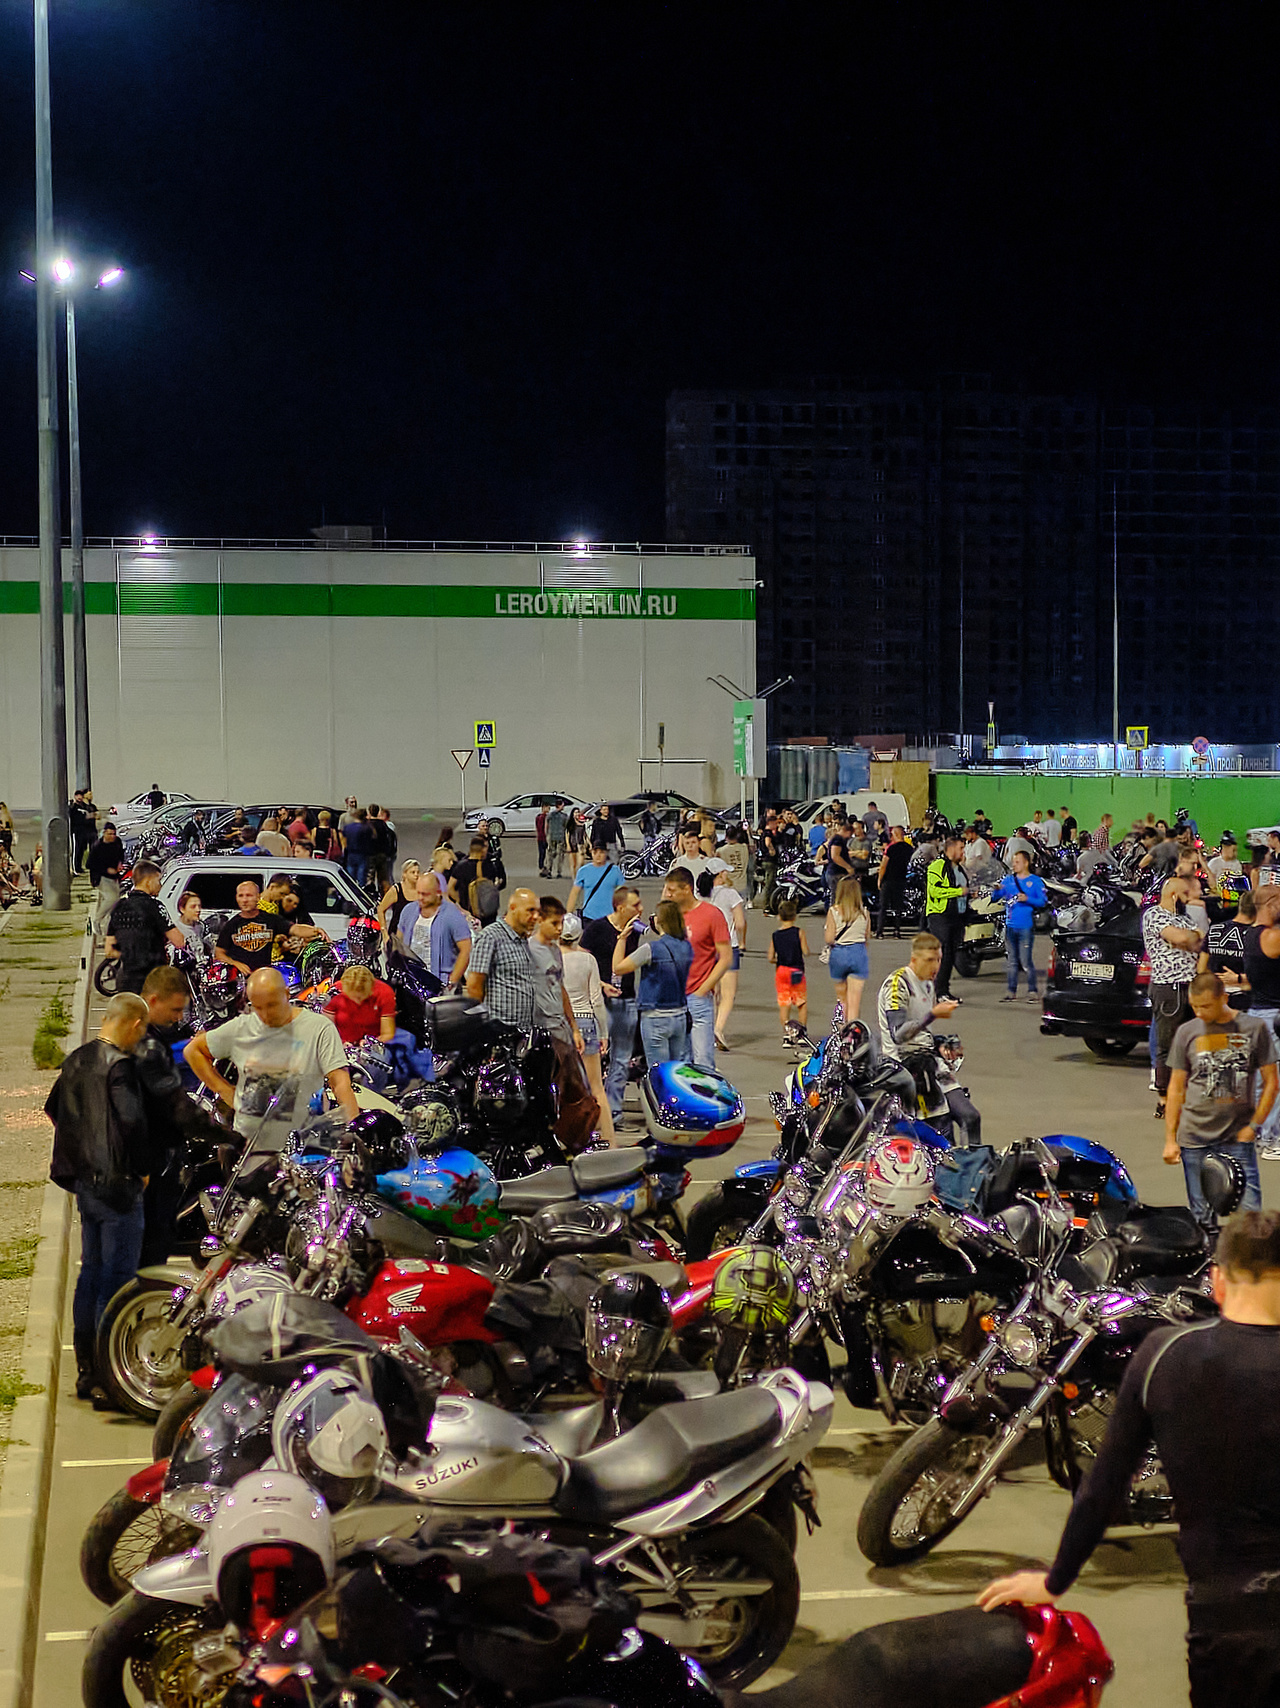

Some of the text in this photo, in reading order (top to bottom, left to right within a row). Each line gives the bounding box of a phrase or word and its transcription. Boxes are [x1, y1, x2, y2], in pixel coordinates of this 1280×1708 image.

[495, 593, 677, 615] LEROYMERLIN.RU
[1208, 924, 1244, 950] EA
[388, 1305, 427, 1315] HONDA
[415, 1456, 479, 1490] SUZUKI
